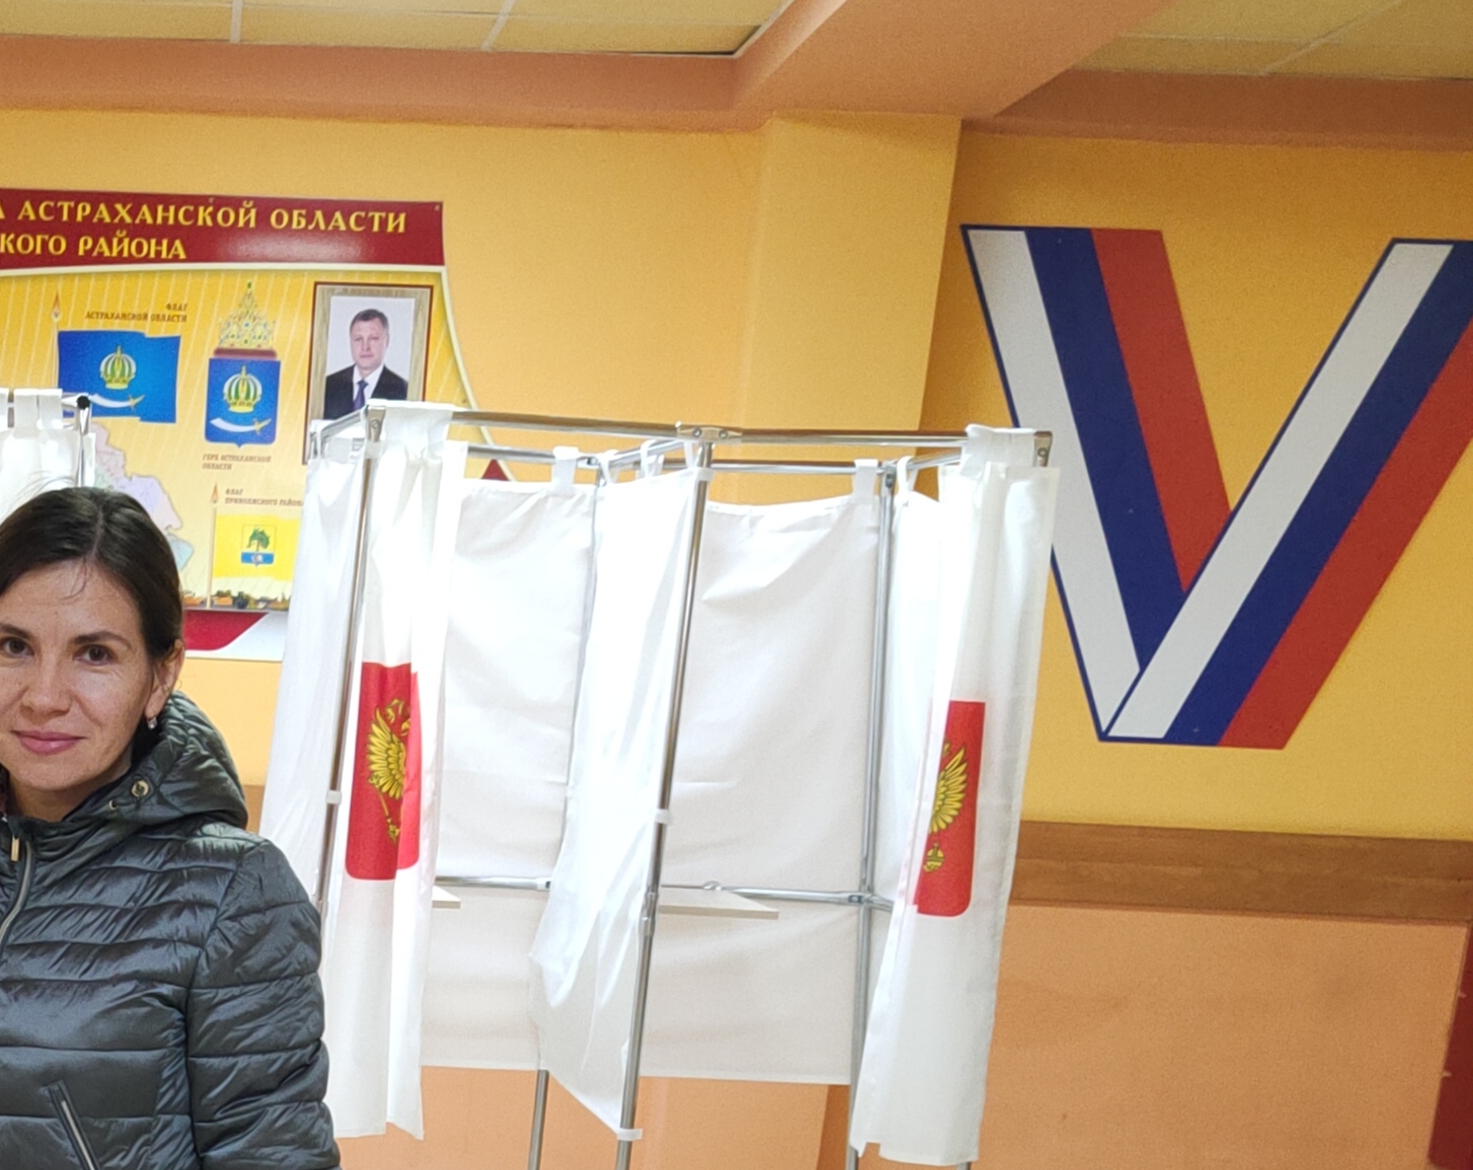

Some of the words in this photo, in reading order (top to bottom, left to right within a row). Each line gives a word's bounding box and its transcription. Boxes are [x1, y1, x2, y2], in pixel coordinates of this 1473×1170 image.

[18, 200, 257, 229] АСТРАХАНСКОЙ
[270, 208, 407, 234] ОБЛАСТИ
[78, 230, 187, 260] РАЙОНА
